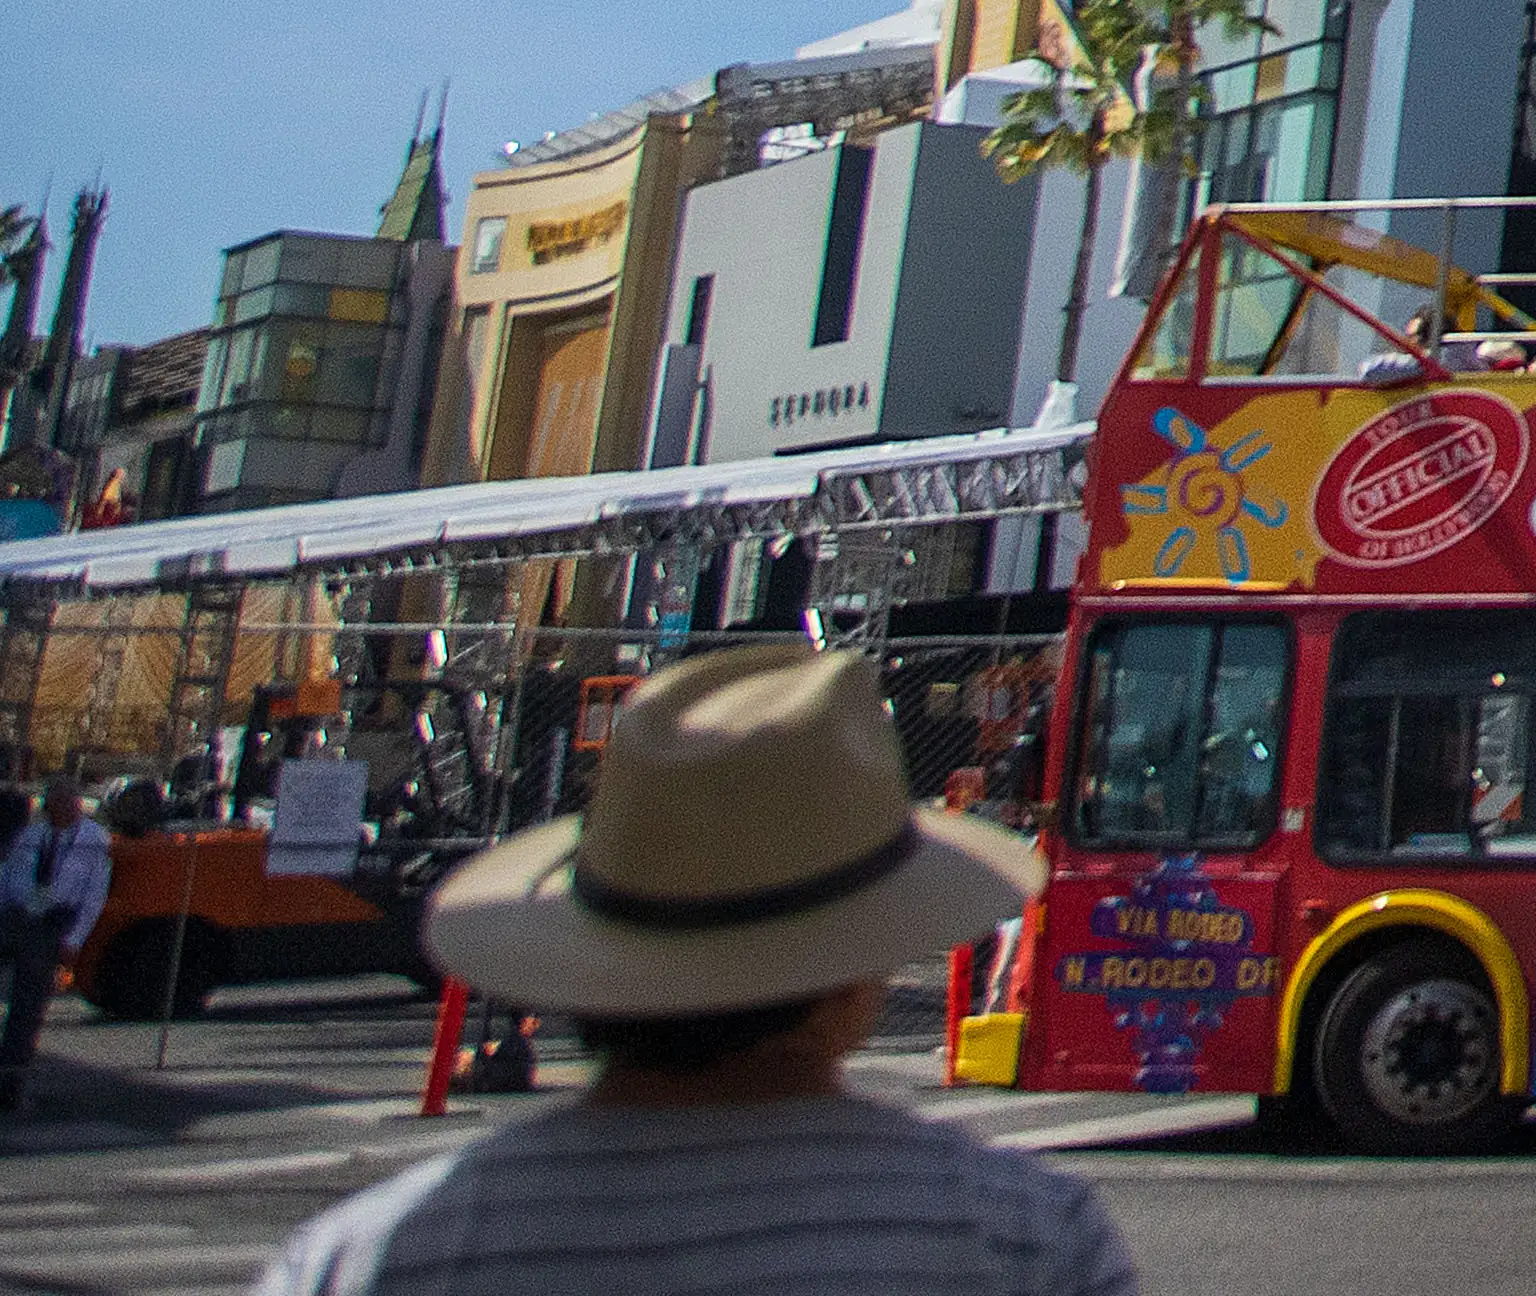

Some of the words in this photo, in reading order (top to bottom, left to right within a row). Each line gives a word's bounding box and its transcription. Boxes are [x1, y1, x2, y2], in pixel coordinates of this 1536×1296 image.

[770, 381, 870, 428] SEPHORA
[1350, 433, 1488, 521] OFFICIAL
[1116, 906, 1158, 936] VIA
[1101, 956, 1216, 989] RODEO
